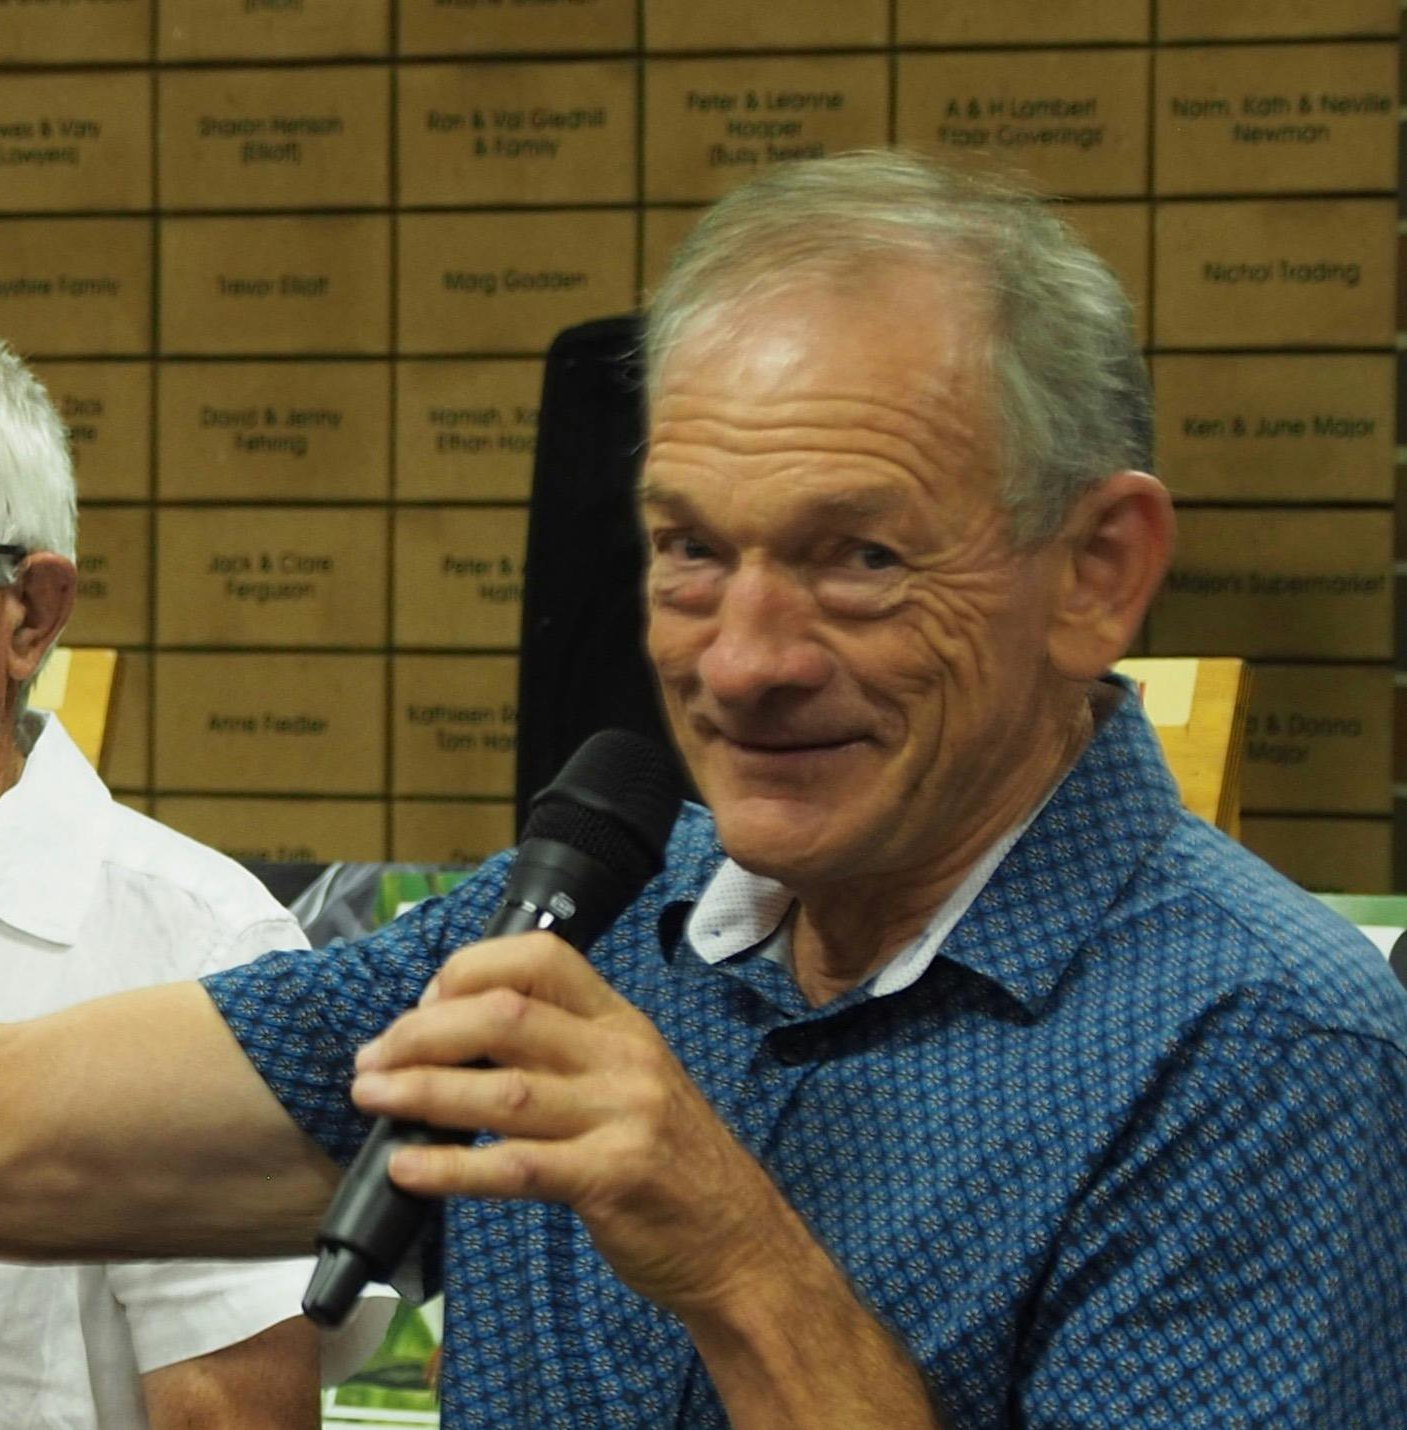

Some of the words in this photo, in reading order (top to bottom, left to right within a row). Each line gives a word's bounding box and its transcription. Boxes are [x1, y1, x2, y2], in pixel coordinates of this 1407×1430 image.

[687, 91, 738, 112] Peter
[745, 90, 760, 110] &
[1299, 94, 1313, 114] &
[1232, 124, 1331, 145] Newman
[1232, 417, 1246, 437] &
[1253, 416, 1307, 440] June
[1311, 415, 1375, 441] Major
